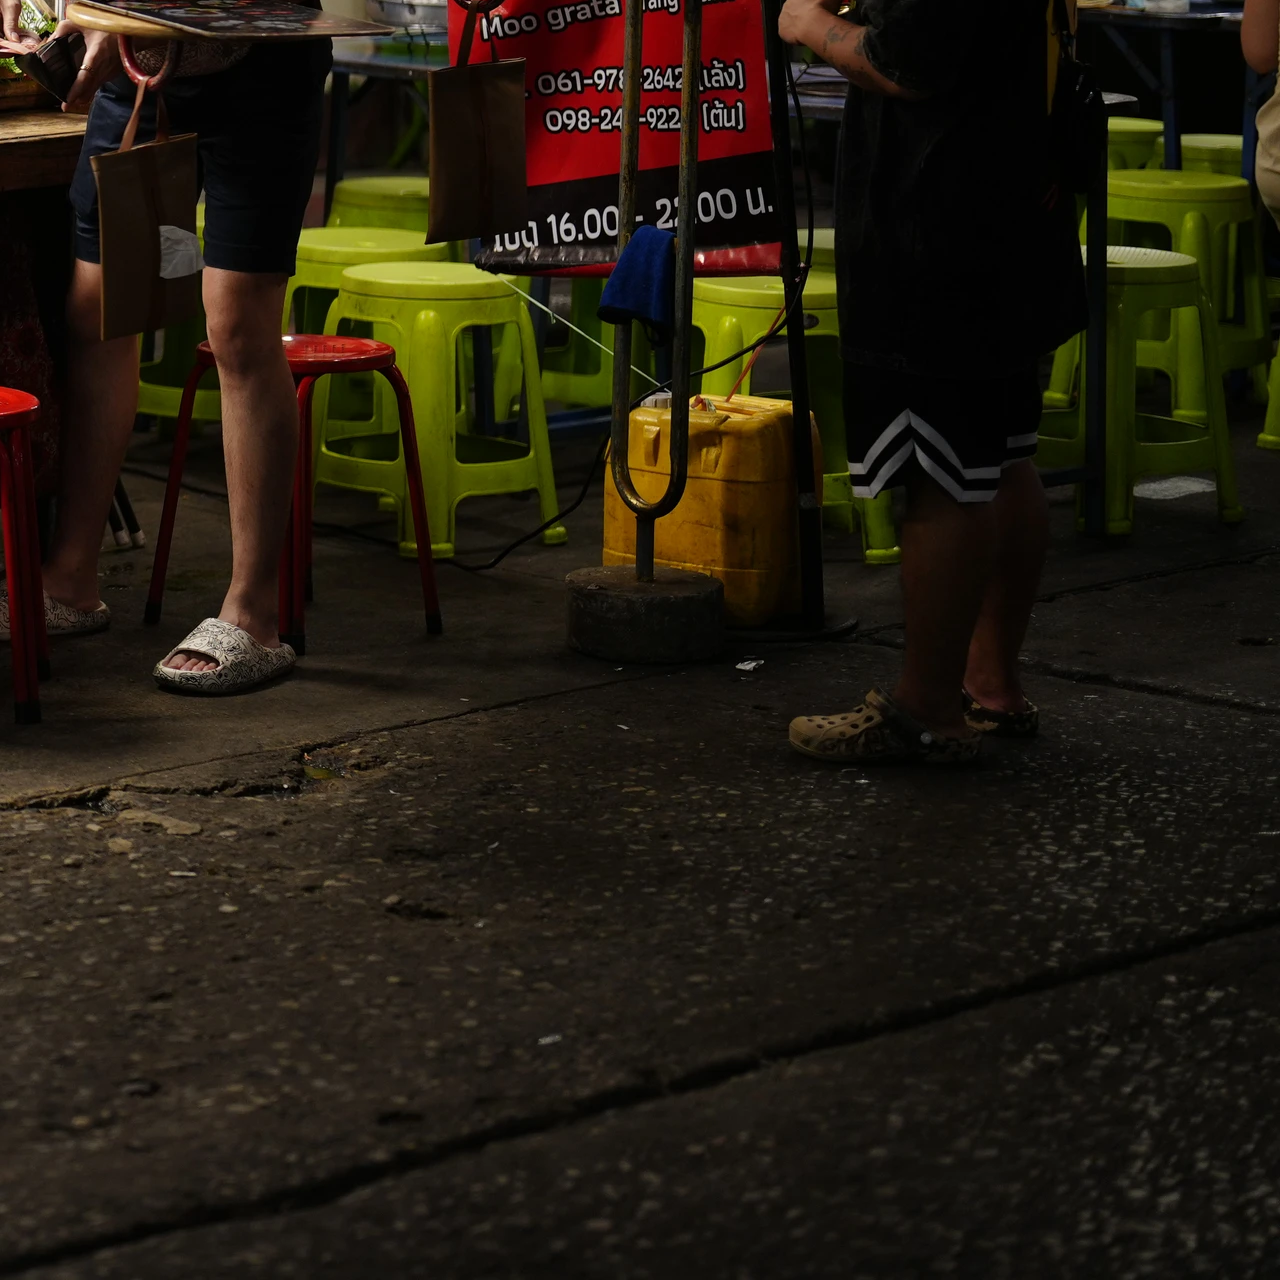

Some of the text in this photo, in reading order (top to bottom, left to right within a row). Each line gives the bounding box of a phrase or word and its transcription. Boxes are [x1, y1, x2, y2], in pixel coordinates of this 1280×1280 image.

[481, 15, 537, 40] Moo
[538, 67, 683, 95] 061-9782642
[545, 108, 681, 132] 098-24-922
[547, 205, 619, 245] 16.00
